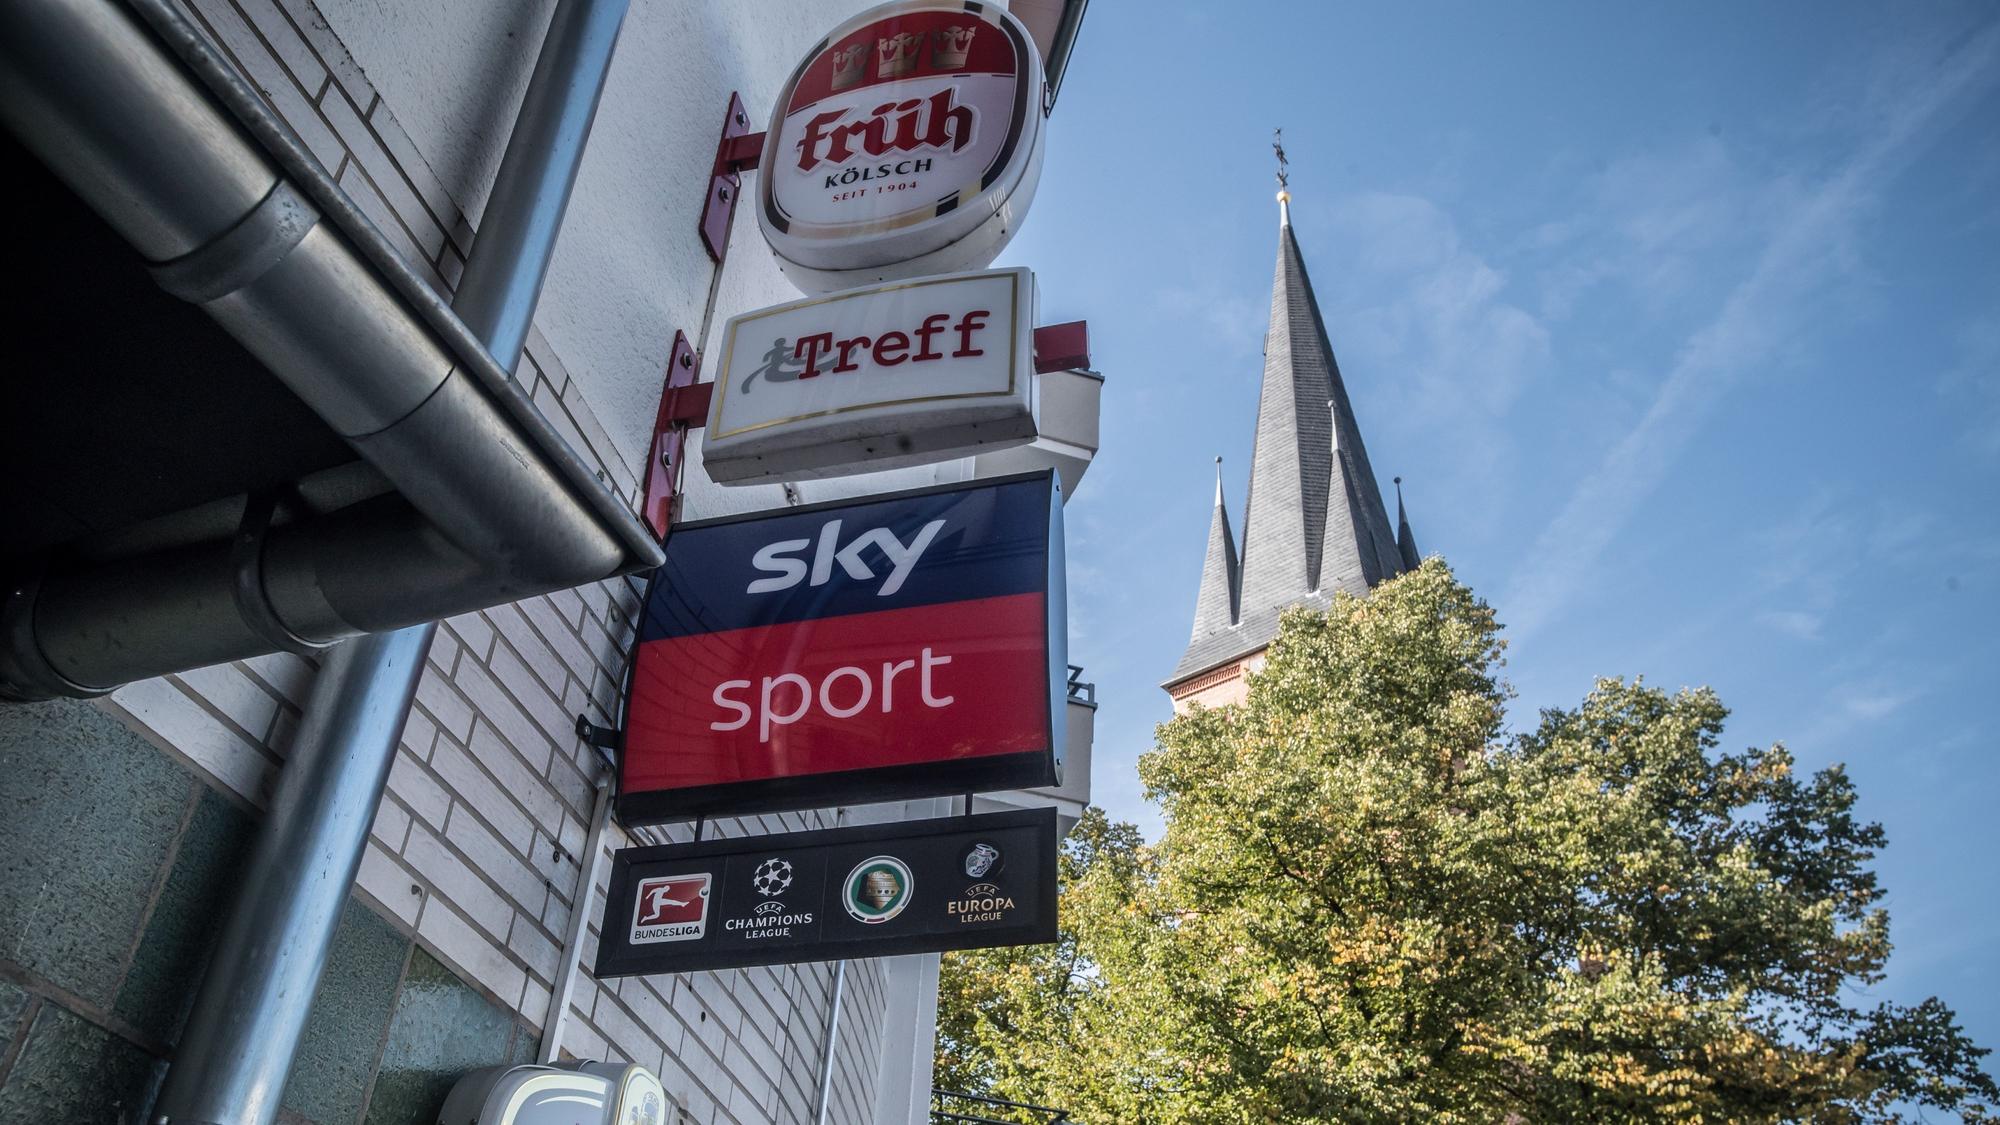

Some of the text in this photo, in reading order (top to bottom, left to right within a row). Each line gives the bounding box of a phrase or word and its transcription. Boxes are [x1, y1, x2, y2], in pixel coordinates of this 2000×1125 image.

[824, 158, 933, 189] KÖLSCH
[832, 181, 917, 203] SEIT 1904
[794, 310, 990, 380] Treff
[746, 519, 947, 597] sky
[710, 647, 954, 743] sport
[967, 886, 996, 896] UEFA
[756, 904, 782, 914] UEFA
[947, 897, 1016, 915] EUROPA
[725, 913, 813, 931] CHAMPIONS
[961, 912, 1002, 924] LEAGUE
[634, 925, 701, 940] BUNDESLIGA
[745, 927, 790, 940] LEAGUE
